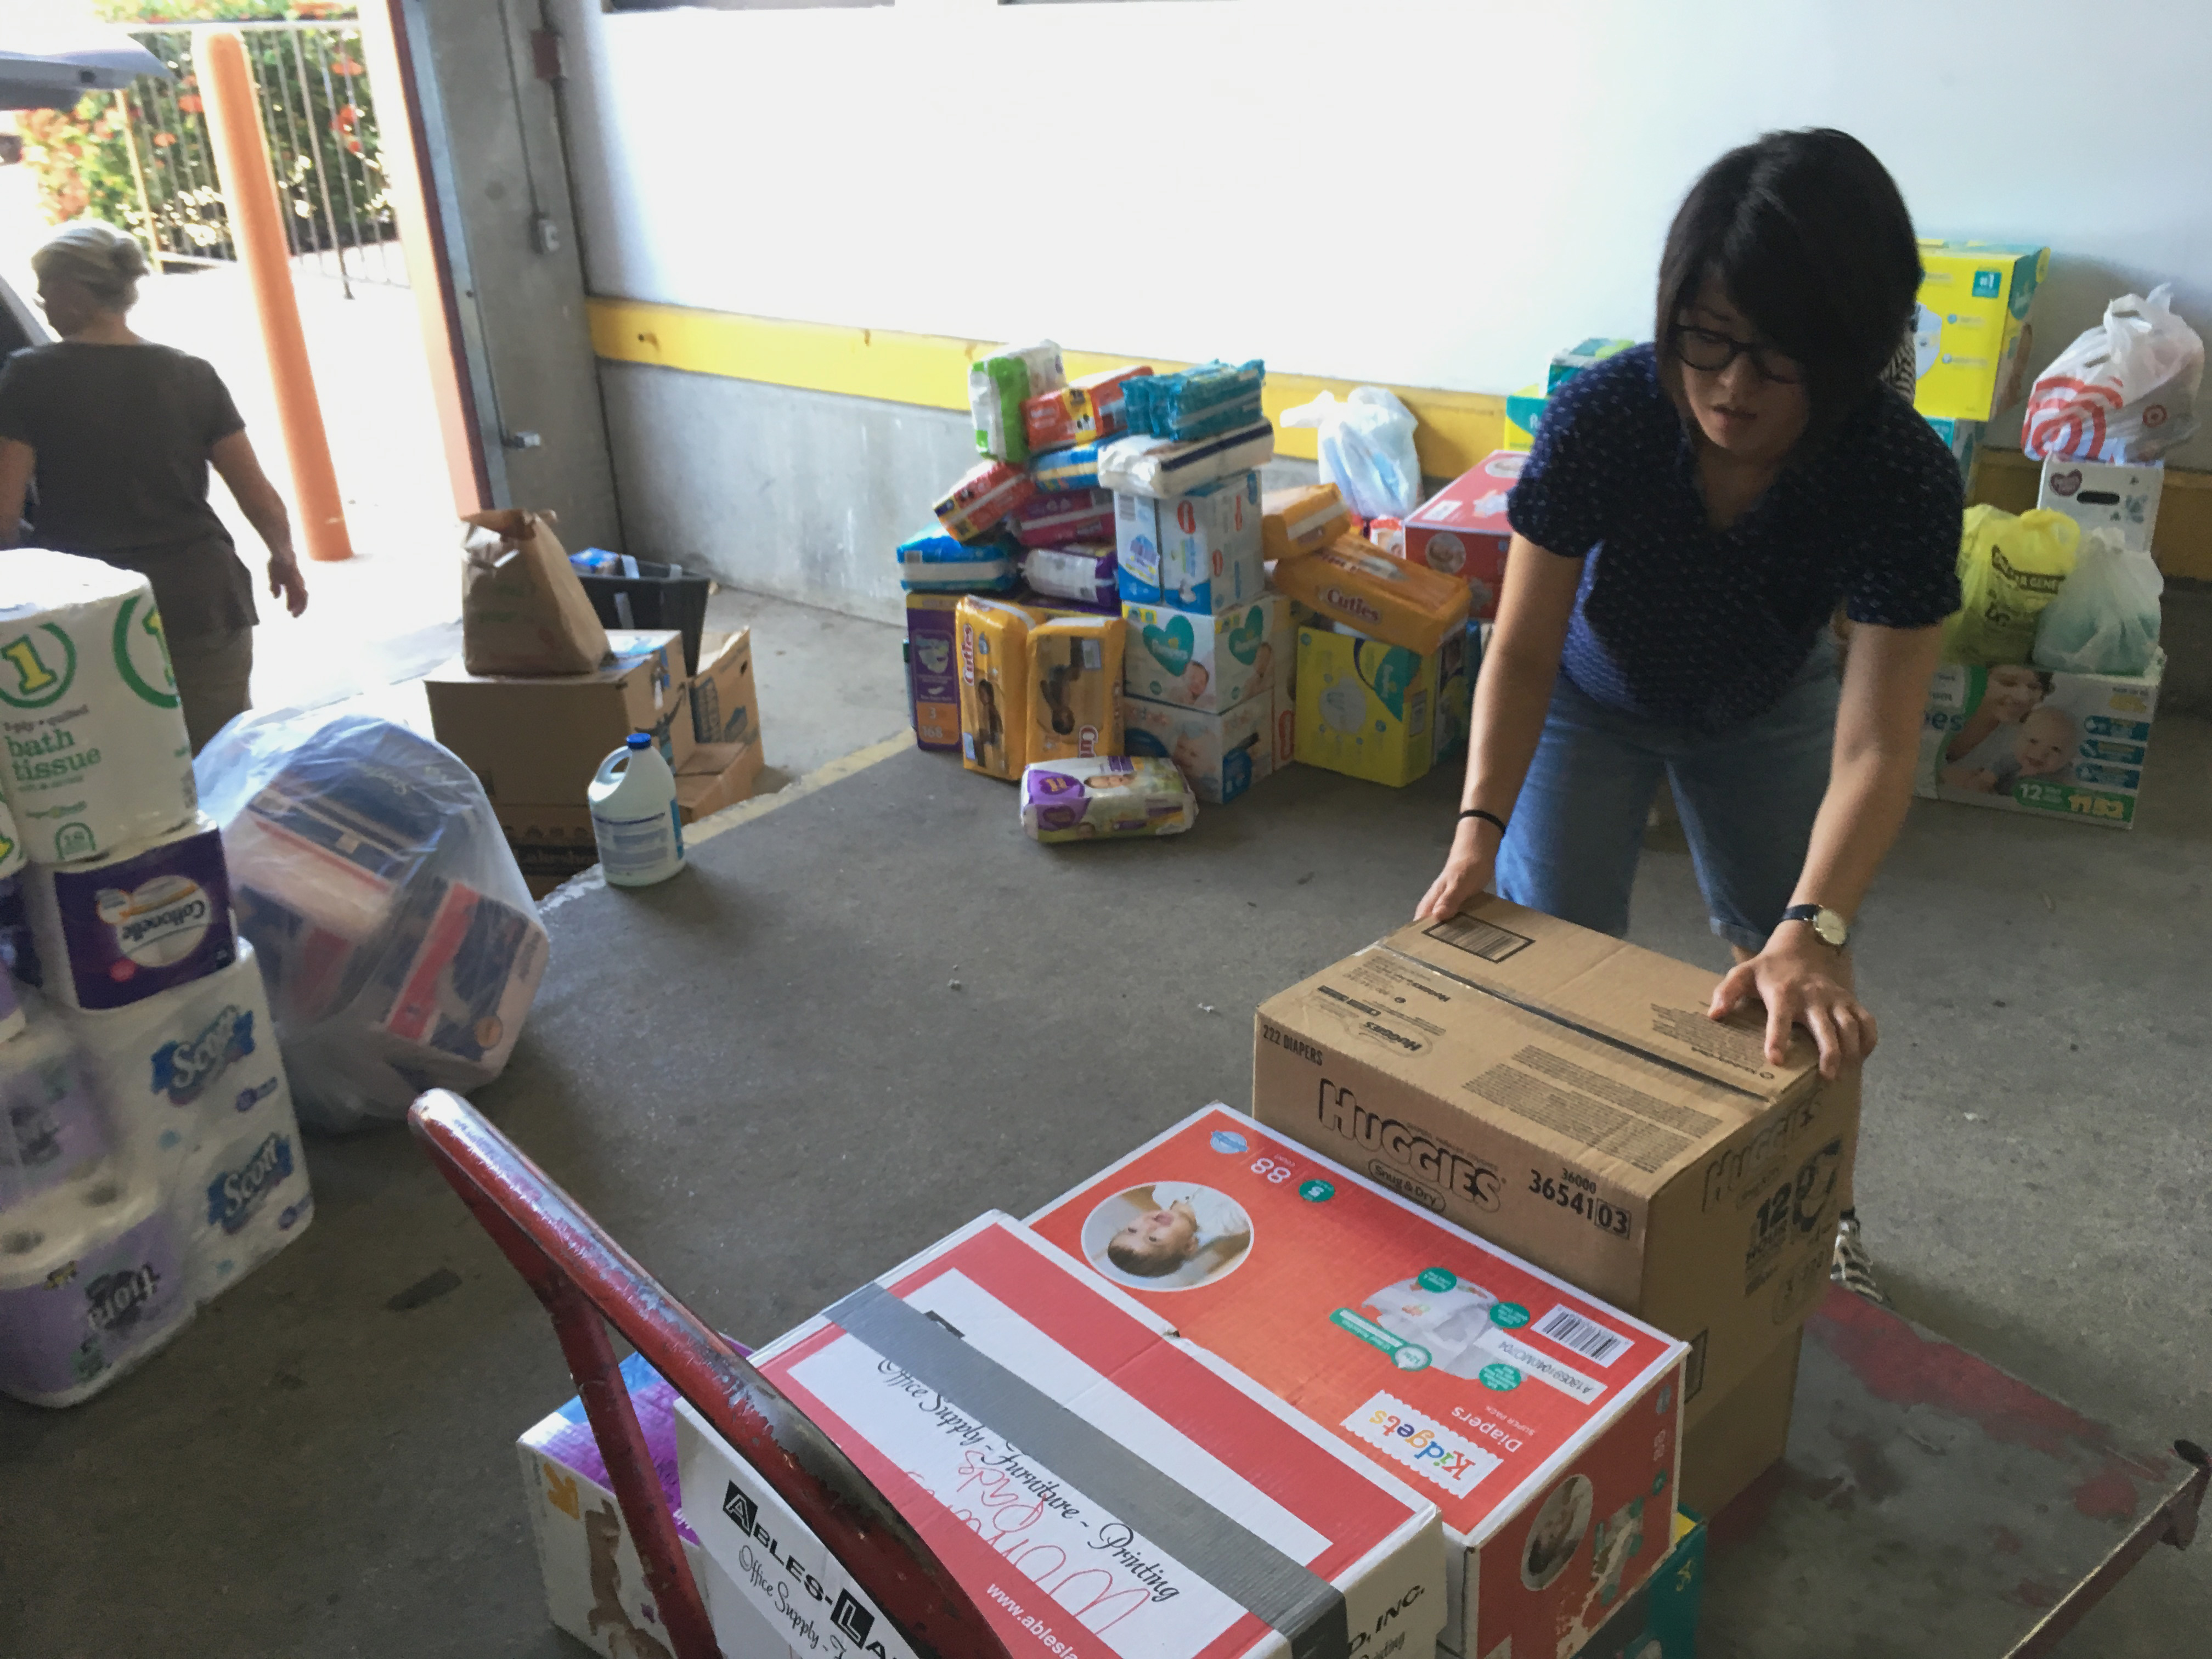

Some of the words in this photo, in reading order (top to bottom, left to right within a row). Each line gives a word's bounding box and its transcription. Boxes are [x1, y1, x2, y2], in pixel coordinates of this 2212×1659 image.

[1327, 588, 1380, 622] Cuties
[962, 625, 974, 684] Cuties
[4, 728, 75, 757] bath
[922, 725, 943, 738] 168
[12, 747, 101, 781] tissue
[2019, 783, 2042, 800] 12
[1263, 1024, 1281, 1046] 222
[1283, 1034, 1323, 1066] DIAPERS
[1250, 1157, 1291, 1184] 88
[1561, 1167, 1596, 1195] 36000
[1485, 1404, 1508, 1422] PACK
[1507, 1416, 1536, 1437] SUPER
[1451, 1406, 1523, 1454] Diapers
[918, 1392, 985, 1446] Supply
[980, 1441, 1080, 1520] Furniture
[1087, 1522, 1181, 1603] Printing
[738, 1544, 774, 1598] Office
[774, 1581, 820, 1650] Supply
